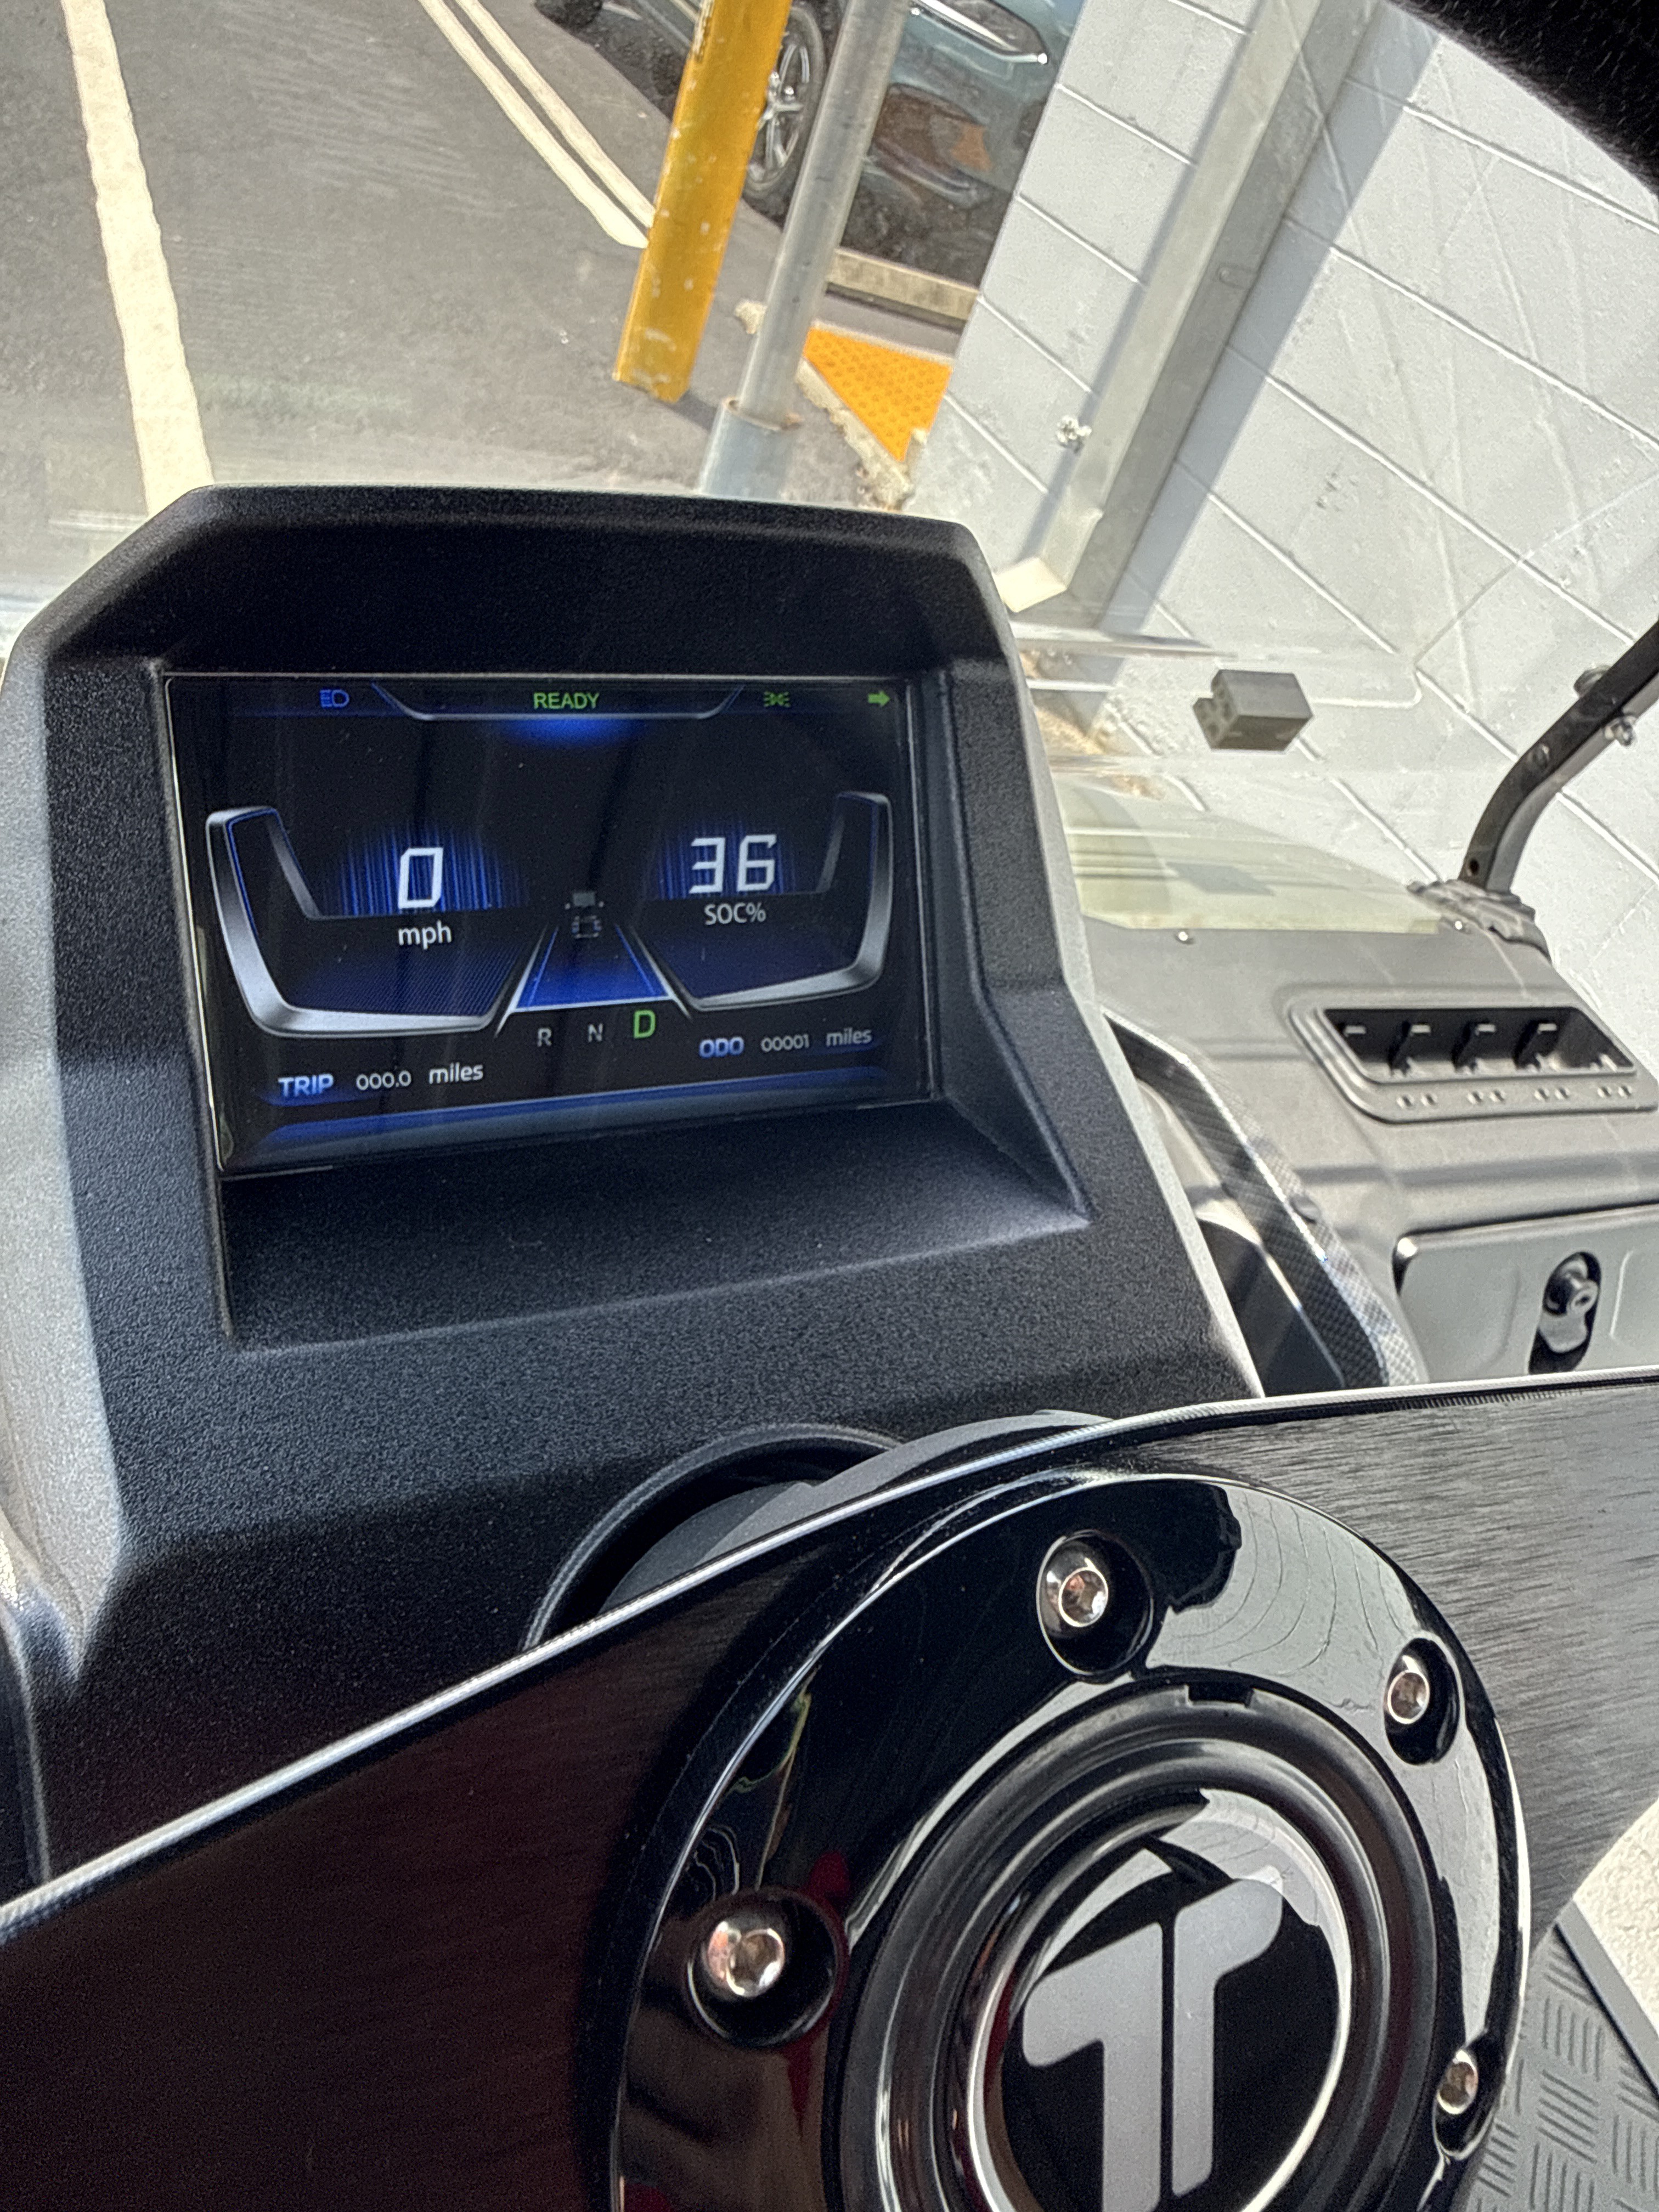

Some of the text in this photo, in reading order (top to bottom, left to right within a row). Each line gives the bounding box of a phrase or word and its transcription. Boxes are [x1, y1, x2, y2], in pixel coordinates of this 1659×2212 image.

[533, 692, 600, 710] READY
[398, 847, 444, 909] 0
[689, 834, 777, 894] 36
[704, 902, 766, 926] SOC%
[398, 921, 453, 950] mph
[537, 1009, 656, 1047] R N D
[699, 1027, 872, 1058] ODO 00001 miles
[278, 1062, 484, 1097] TRIP 000.0 miles
